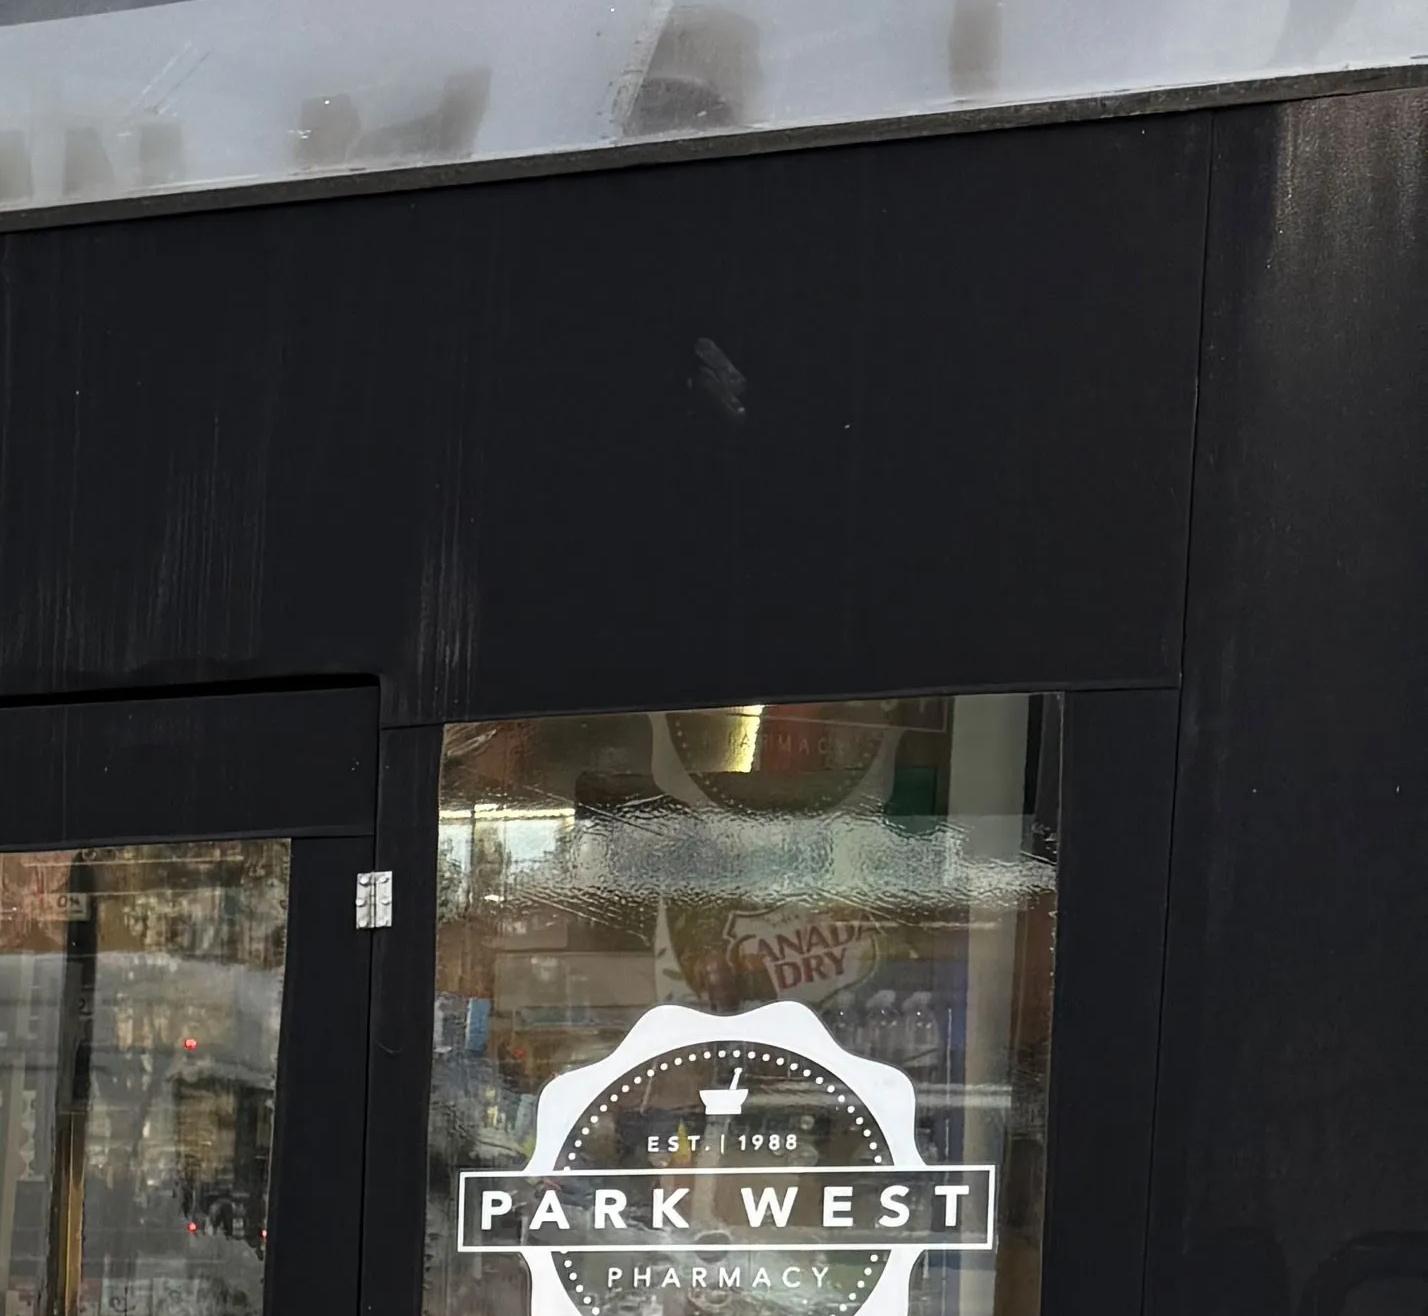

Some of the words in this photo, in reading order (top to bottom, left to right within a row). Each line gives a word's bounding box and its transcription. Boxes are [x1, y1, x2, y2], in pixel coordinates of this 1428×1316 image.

[774, 947, 848, 990] DRY
[647, 1135, 710, 1153] EST.
[738, 1134, 799, 1151] 1988
[481, 1187, 690, 1230] PARK
[741, 1185, 970, 1228] WEST
[607, 1266, 829, 1289] PHARMACY
